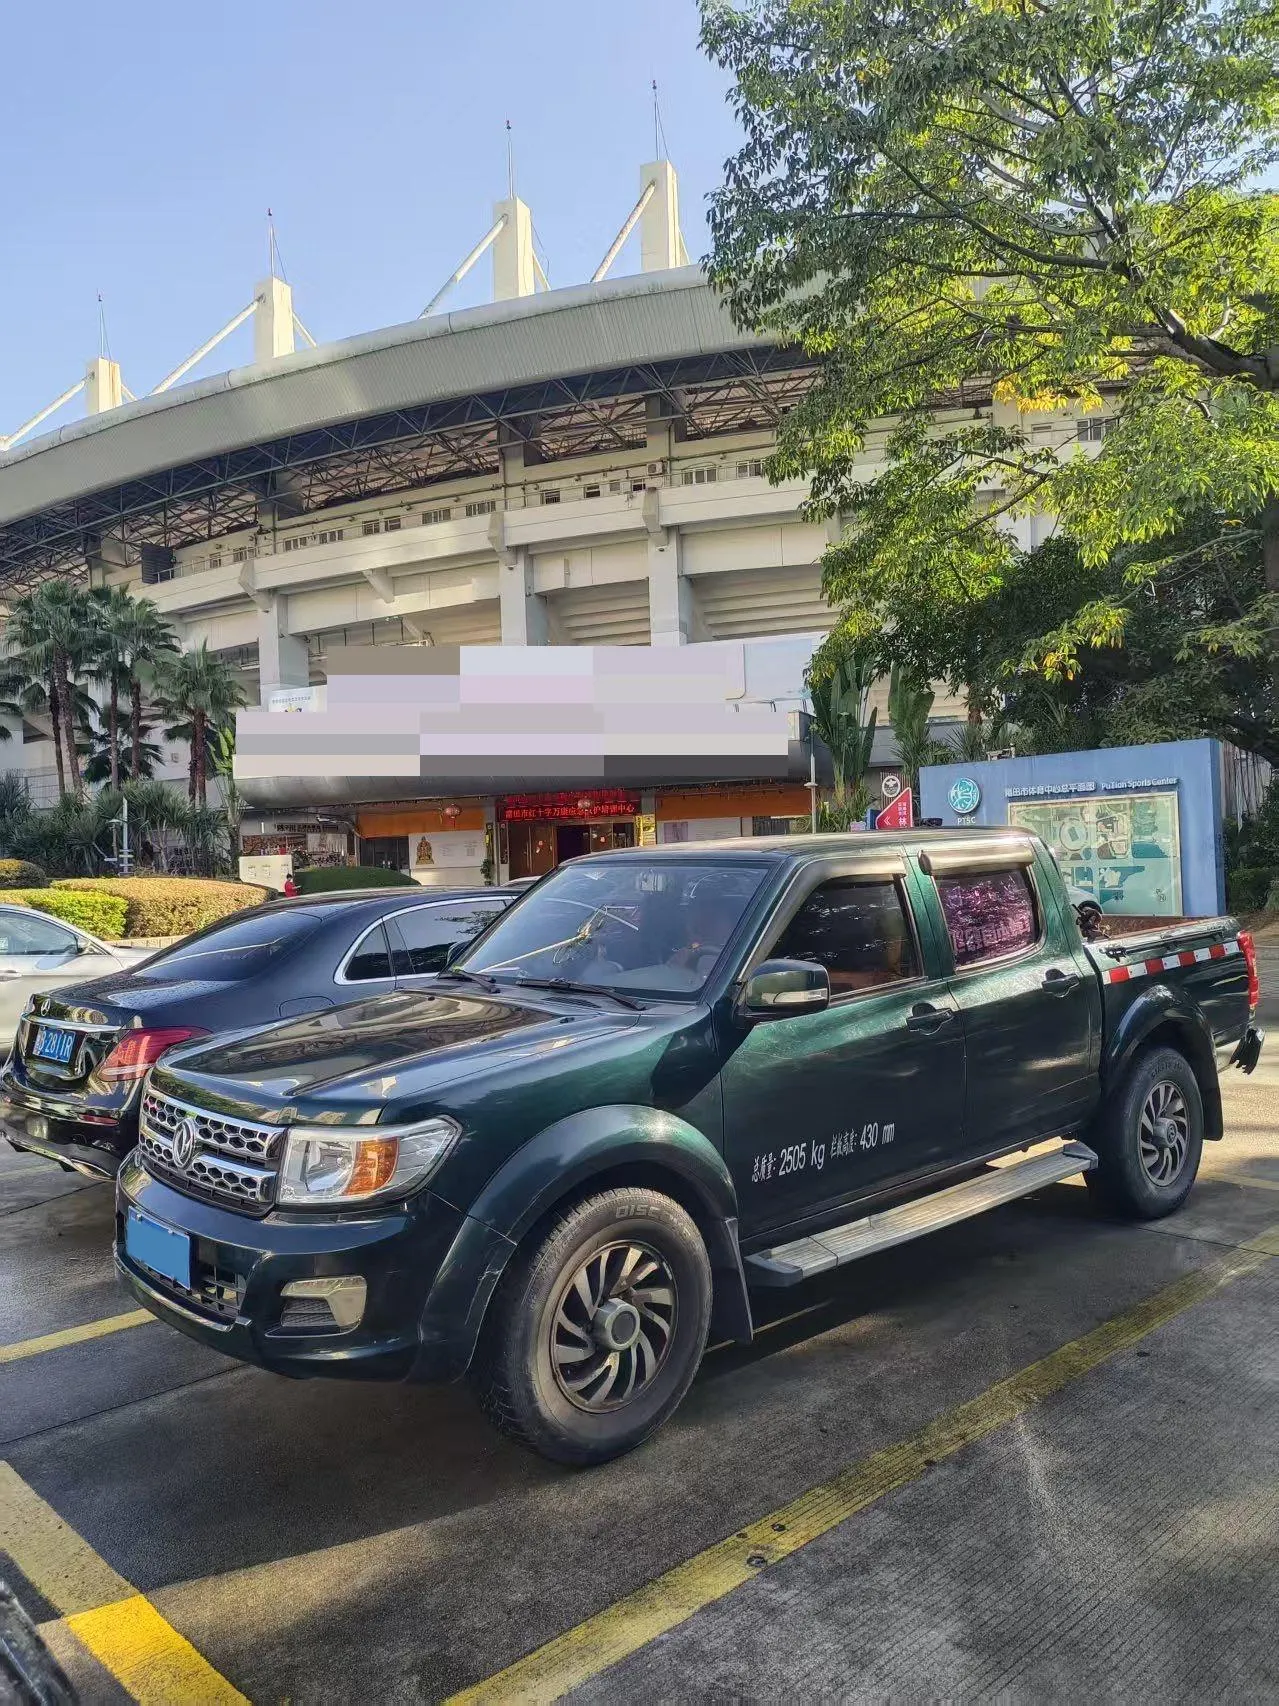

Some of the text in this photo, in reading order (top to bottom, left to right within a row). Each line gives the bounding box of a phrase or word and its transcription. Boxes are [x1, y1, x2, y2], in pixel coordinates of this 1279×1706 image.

[1128, 780, 1151, 788] Sports
[1152, 777, 1178, 786] Center
[957, 816, 976, 825] PTSC
[779, 1142, 807, 1177] 2505
[810, 1139, 825, 1170] kg
[860, 1122, 879, 1150] 430
[881, 1122, 896, 1145] mm
